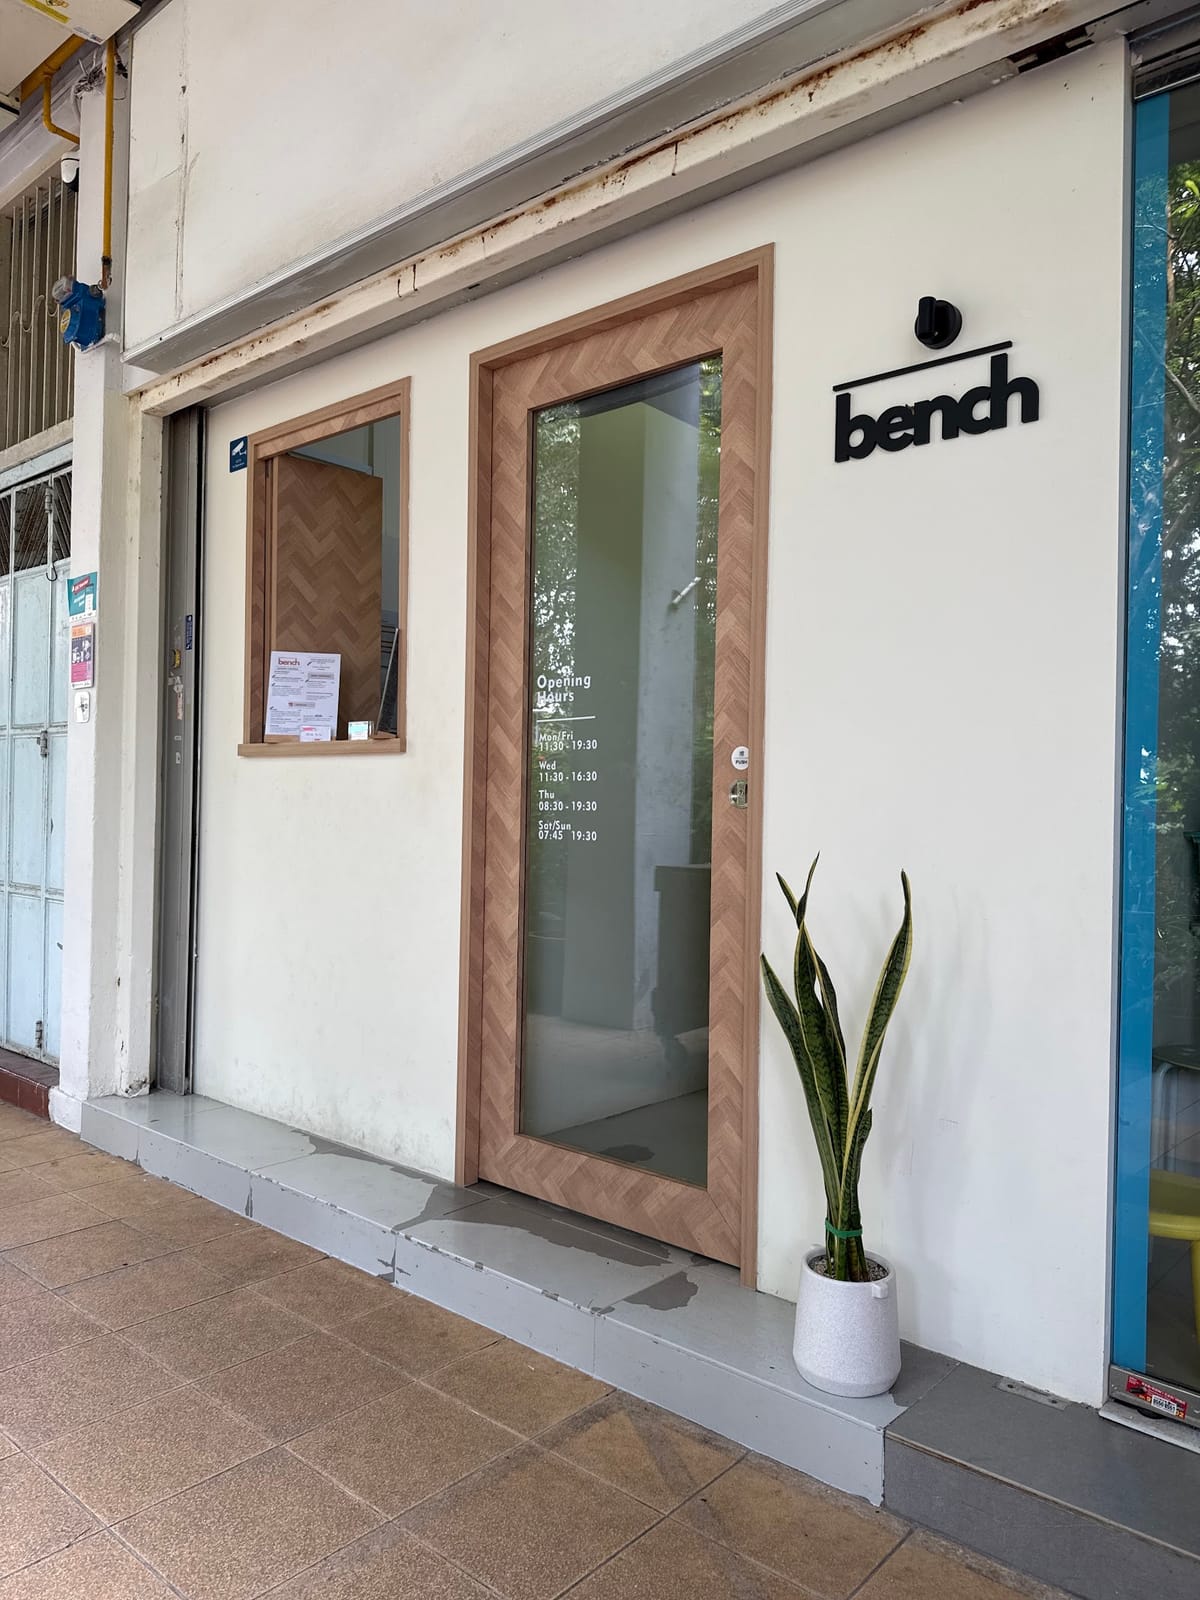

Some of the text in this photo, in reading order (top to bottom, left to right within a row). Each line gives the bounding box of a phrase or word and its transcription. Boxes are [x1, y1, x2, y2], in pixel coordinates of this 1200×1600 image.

[835, 353, 1039, 463] bench
[537, 675, 591, 690] Opening
[537, 691, 575, 702] Hours
[538, 731, 574, 741] Mon/Fri
[539, 742, 564, 751] 11:30
[572, 740, 598, 750] 19:30
[538, 761, 556, 770] Wed
[539, 772, 564, 782] 11:30
[572, 771, 598, 781] 16:30
[538, 789, 555, 799] Thu
[538, 801, 564, 811] 08:30
[572, 801, 597, 811] 19:30
[538, 820, 572, 831] Sat/Sun
[538, 830, 597, 841] 07:45 19:30
